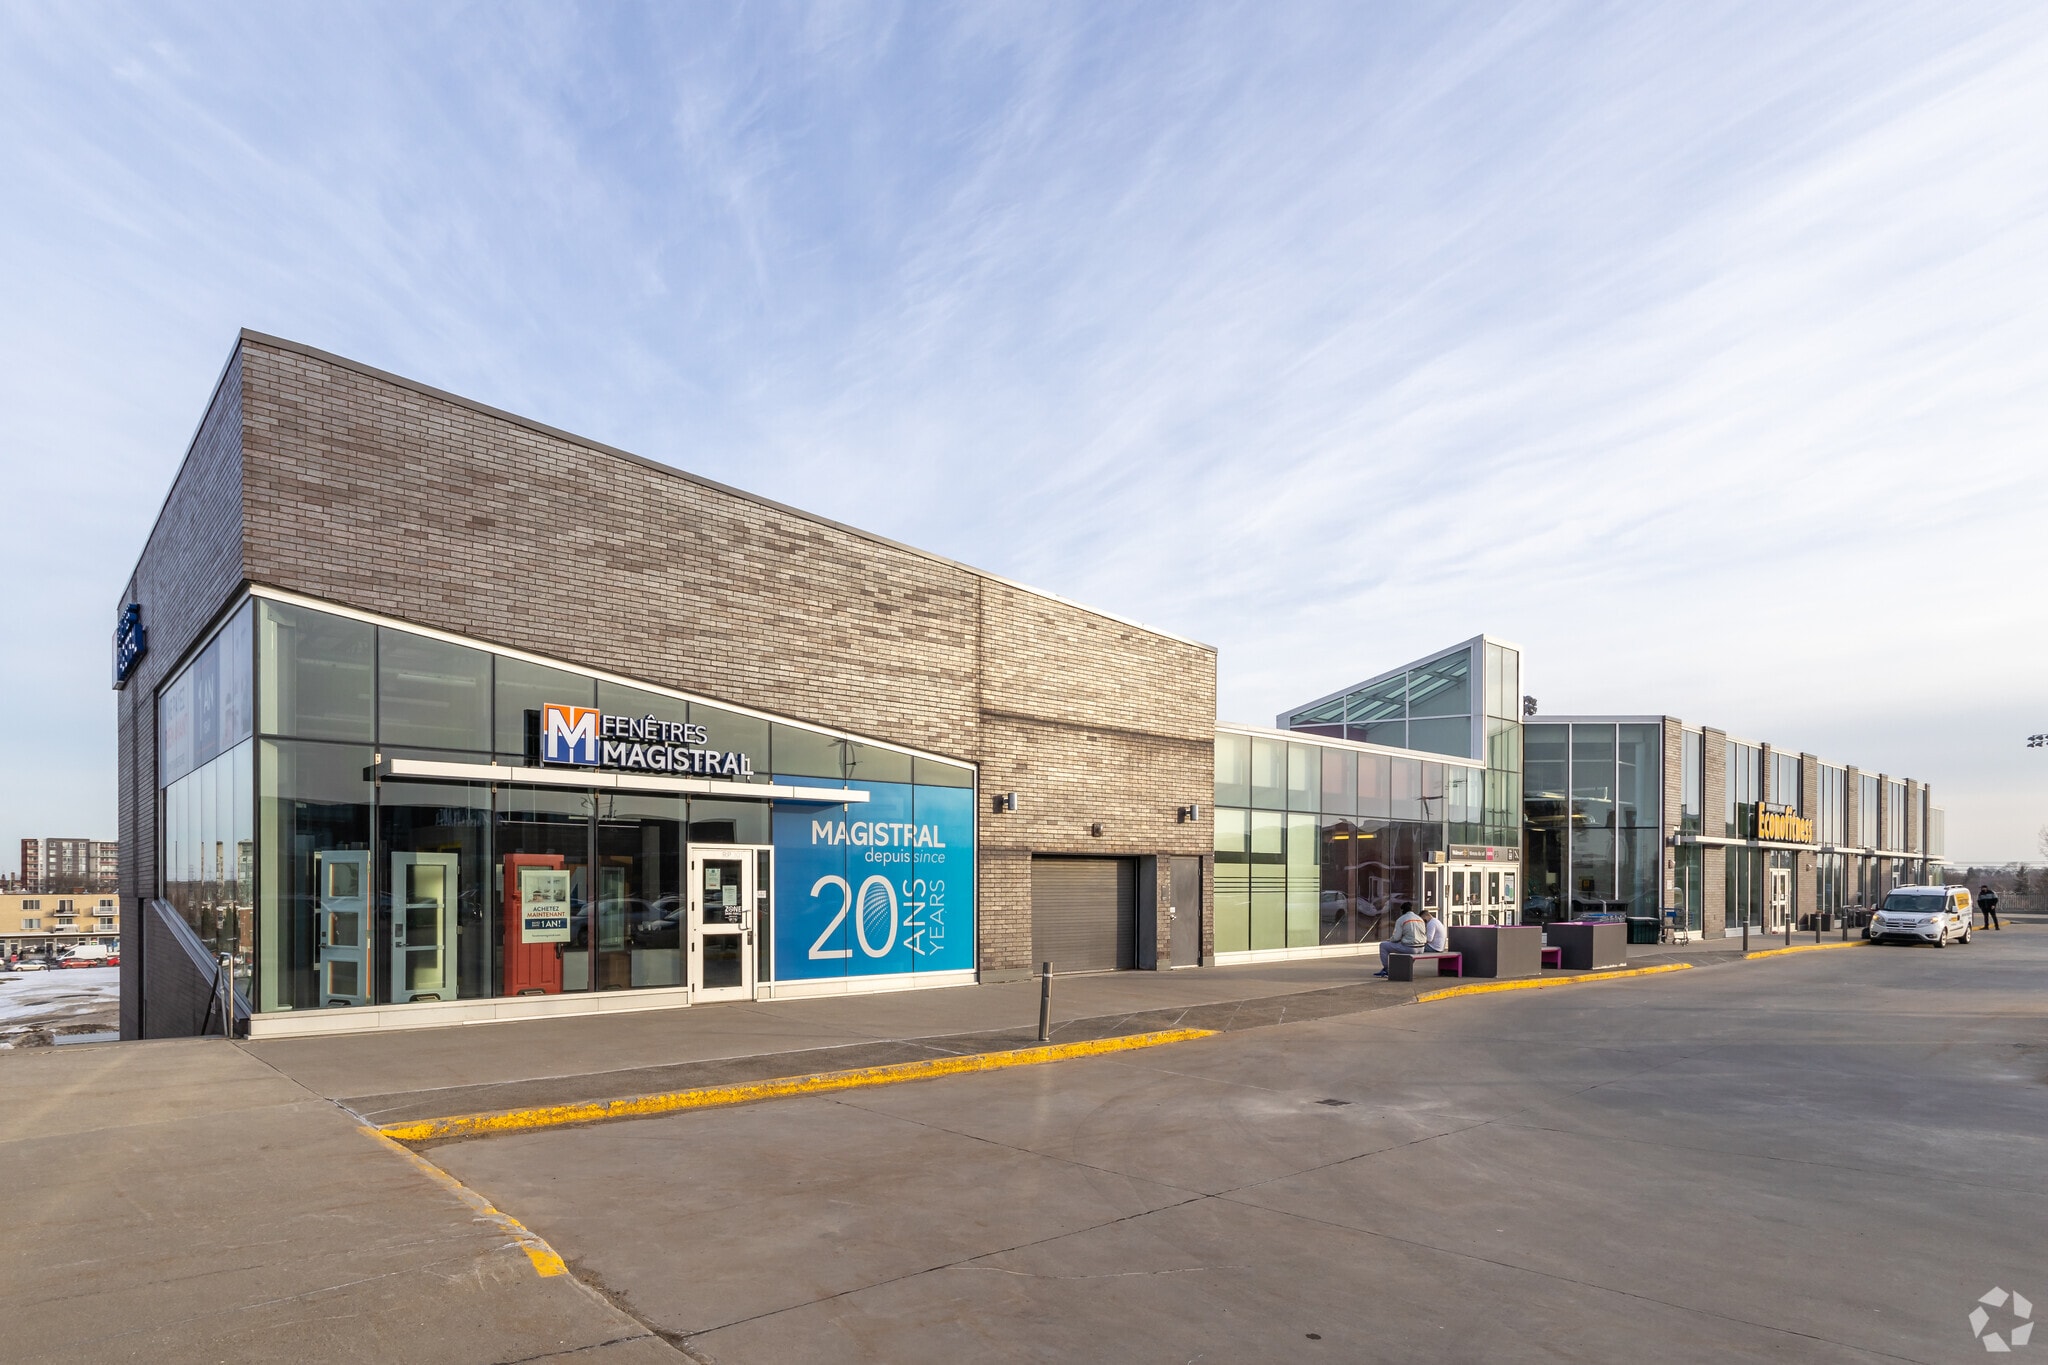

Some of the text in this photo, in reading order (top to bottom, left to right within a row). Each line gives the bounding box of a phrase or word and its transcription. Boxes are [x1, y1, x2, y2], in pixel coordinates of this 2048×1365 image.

[547, 708, 596, 761] M
[602, 714, 708, 745] FENÊTRES
[602, 741, 755, 776] MAGISTRAL
[811, 820, 946, 848] MAGISTRAL
[1758, 801, 1813, 844] Econofitness
[865, 847, 946, 866] depuis since
[808, 874, 898, 960] 20
[902, 878, 926, 956] ANS
[929, 879, 945, 956] YEARS
